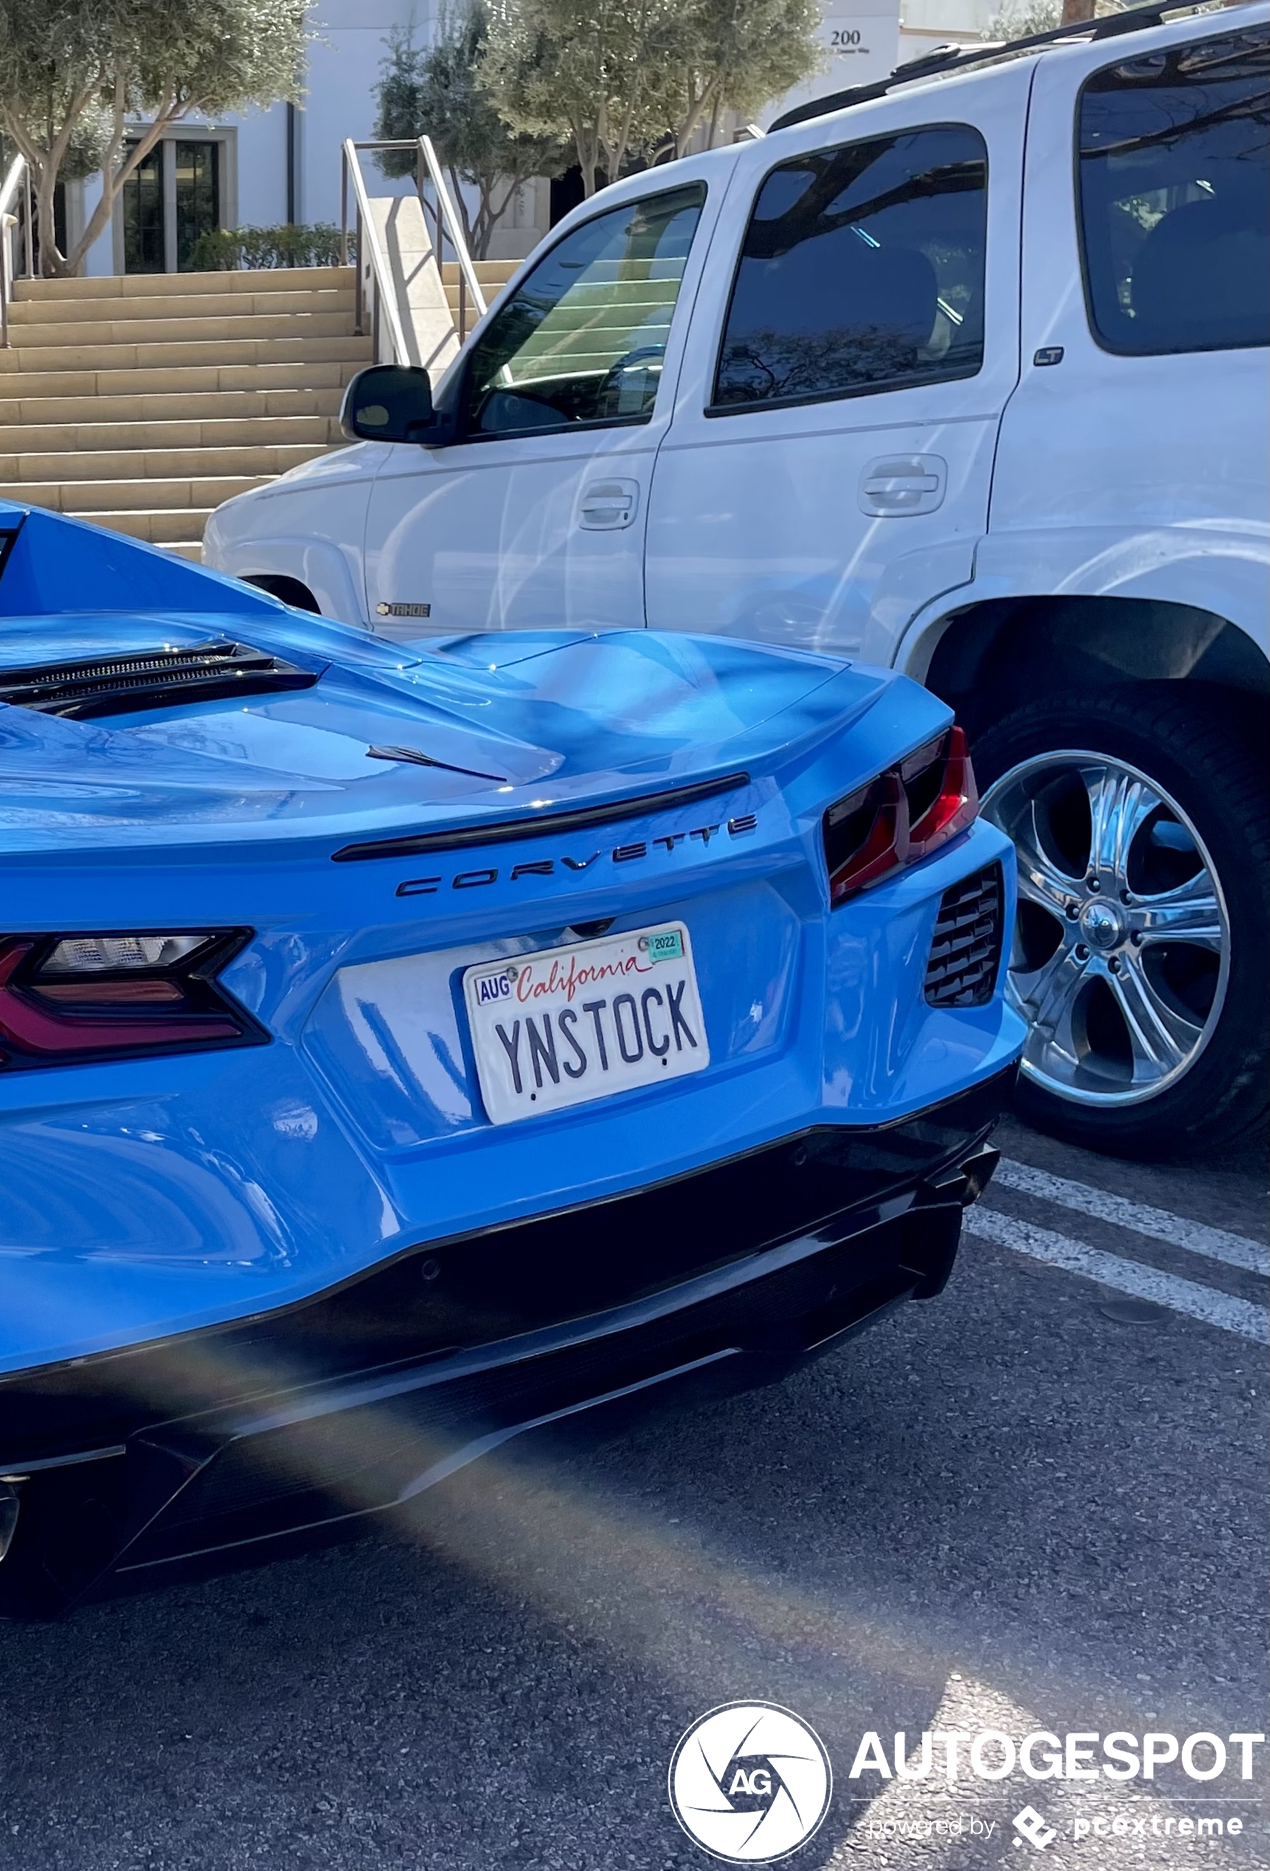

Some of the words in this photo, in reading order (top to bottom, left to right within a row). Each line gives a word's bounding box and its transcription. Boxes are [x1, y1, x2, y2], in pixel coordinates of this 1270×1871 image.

[831, 30, 861, 46] 200
[1035, 349, 1062, 364] LT
[391, 604, 429, 617] TAHOE
[395, 813, 758, 897] CORVETTE
[654, 936, 676, 950] 2022
[516, 950, 653, 1002] California
[481, 975, 510, 1002] AUG
[495, 980, 698, 1094] YNSTOCK
